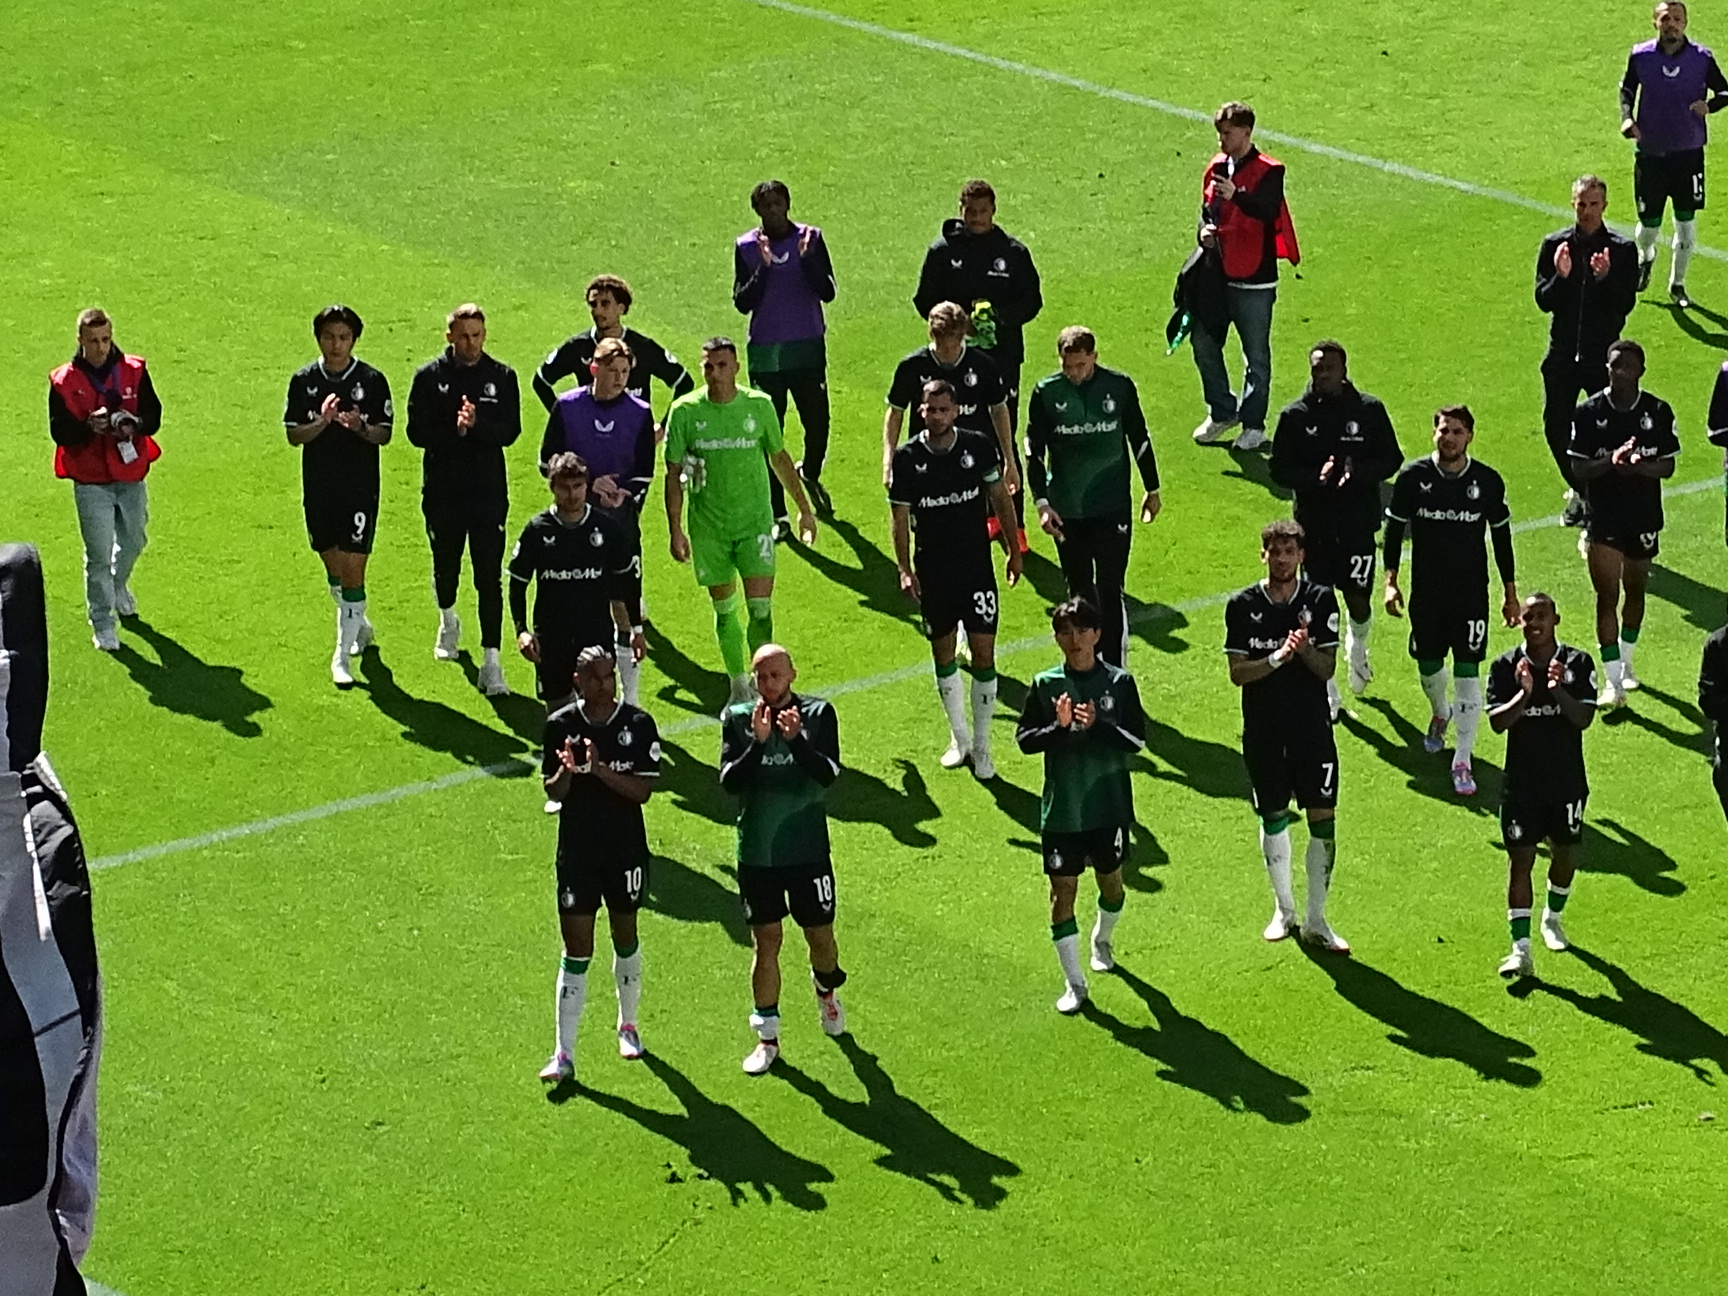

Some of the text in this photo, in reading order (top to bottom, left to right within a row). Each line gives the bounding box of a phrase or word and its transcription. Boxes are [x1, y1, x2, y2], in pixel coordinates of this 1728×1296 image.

[354, 512, 366, 534] 9
[1350, 555, 1373, 578] 27
[973, 590, 996, 615] 33
[1467, 620, 1485, 643] 19
[1322, 763, 1333, 787] 7
[1566, 799, 1583, 825] 14
[1114, 827, 1123, 849] 4
[625, 866, 641, 893] 10
[813, 875, 832, 903] 18
